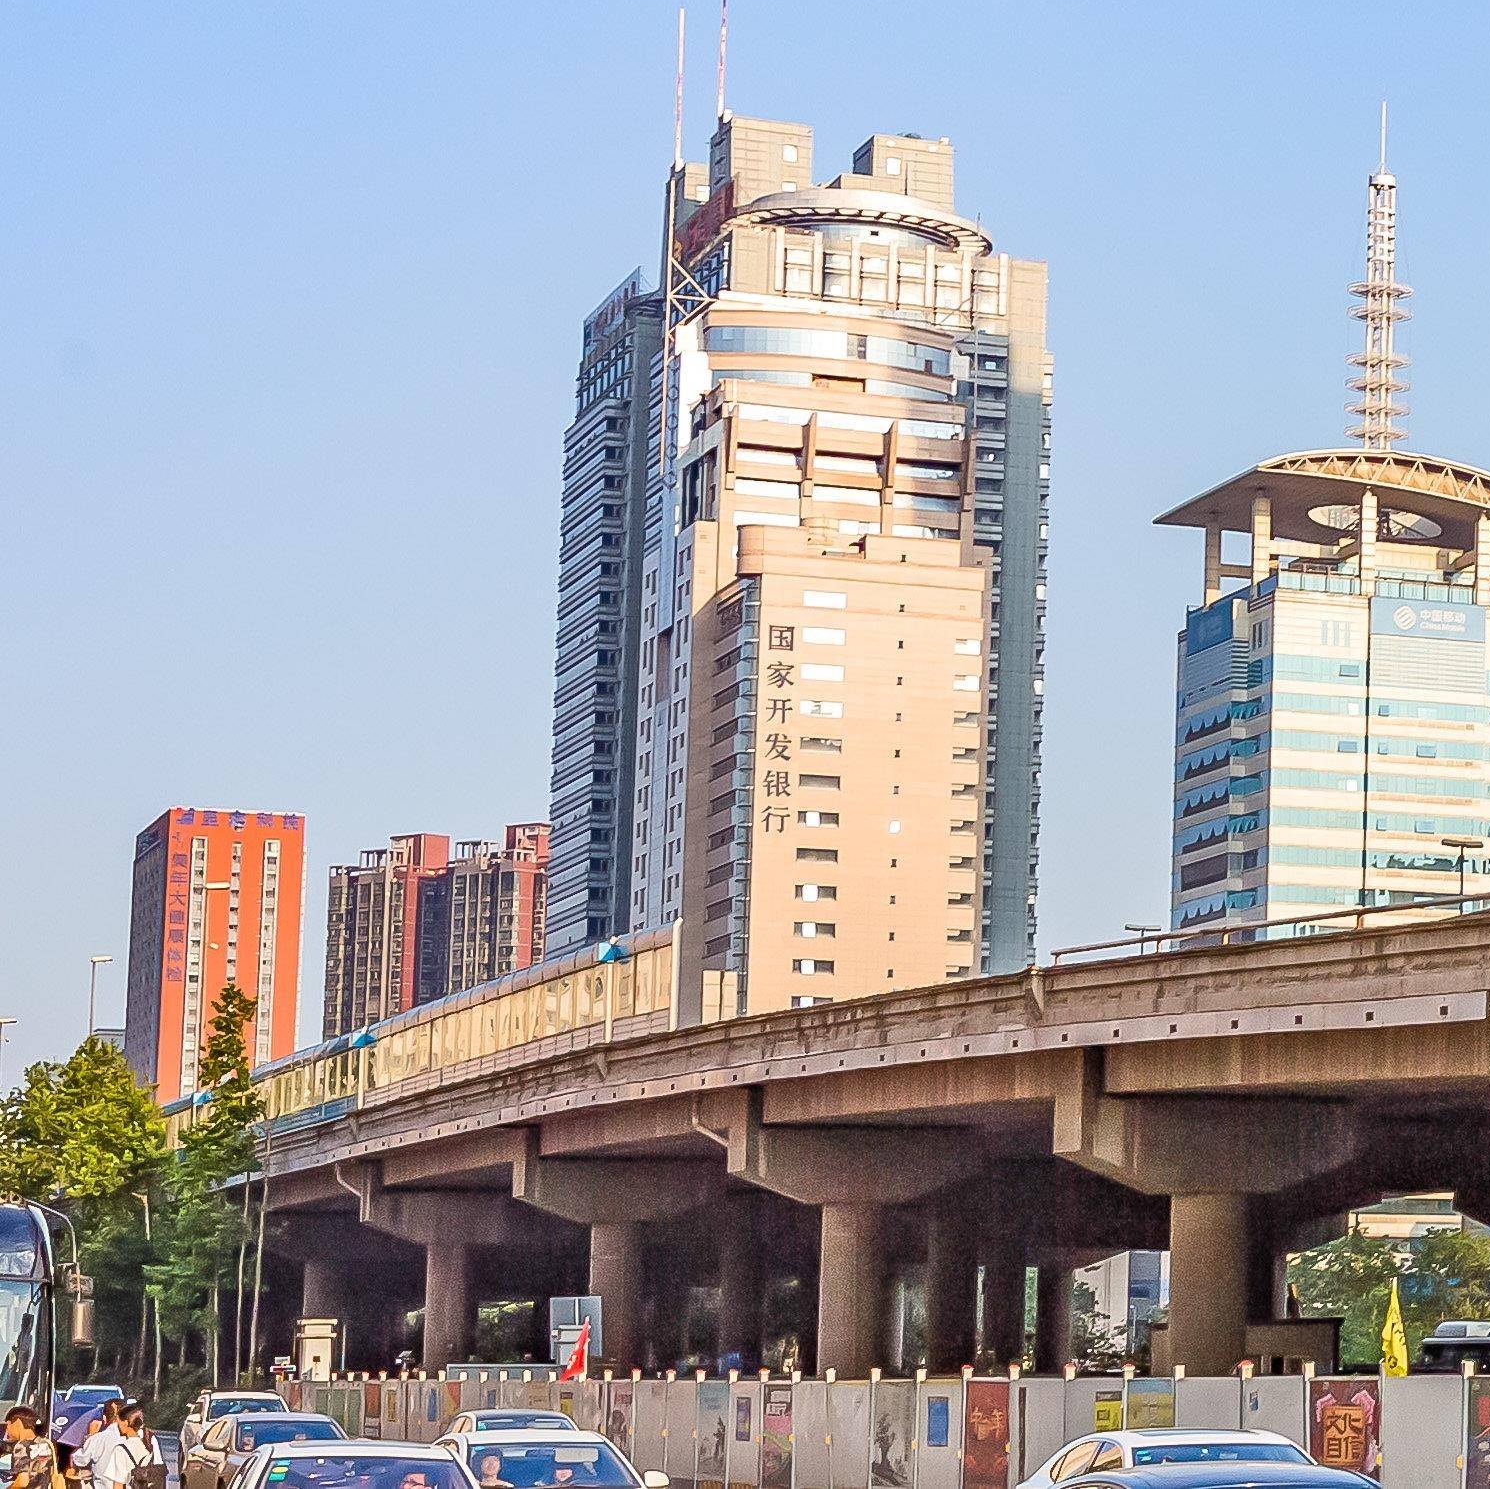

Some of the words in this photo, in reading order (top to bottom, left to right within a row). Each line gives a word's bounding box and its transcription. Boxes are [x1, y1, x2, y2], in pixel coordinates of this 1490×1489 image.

[760, 625, 795, 833] 国家开发银行
